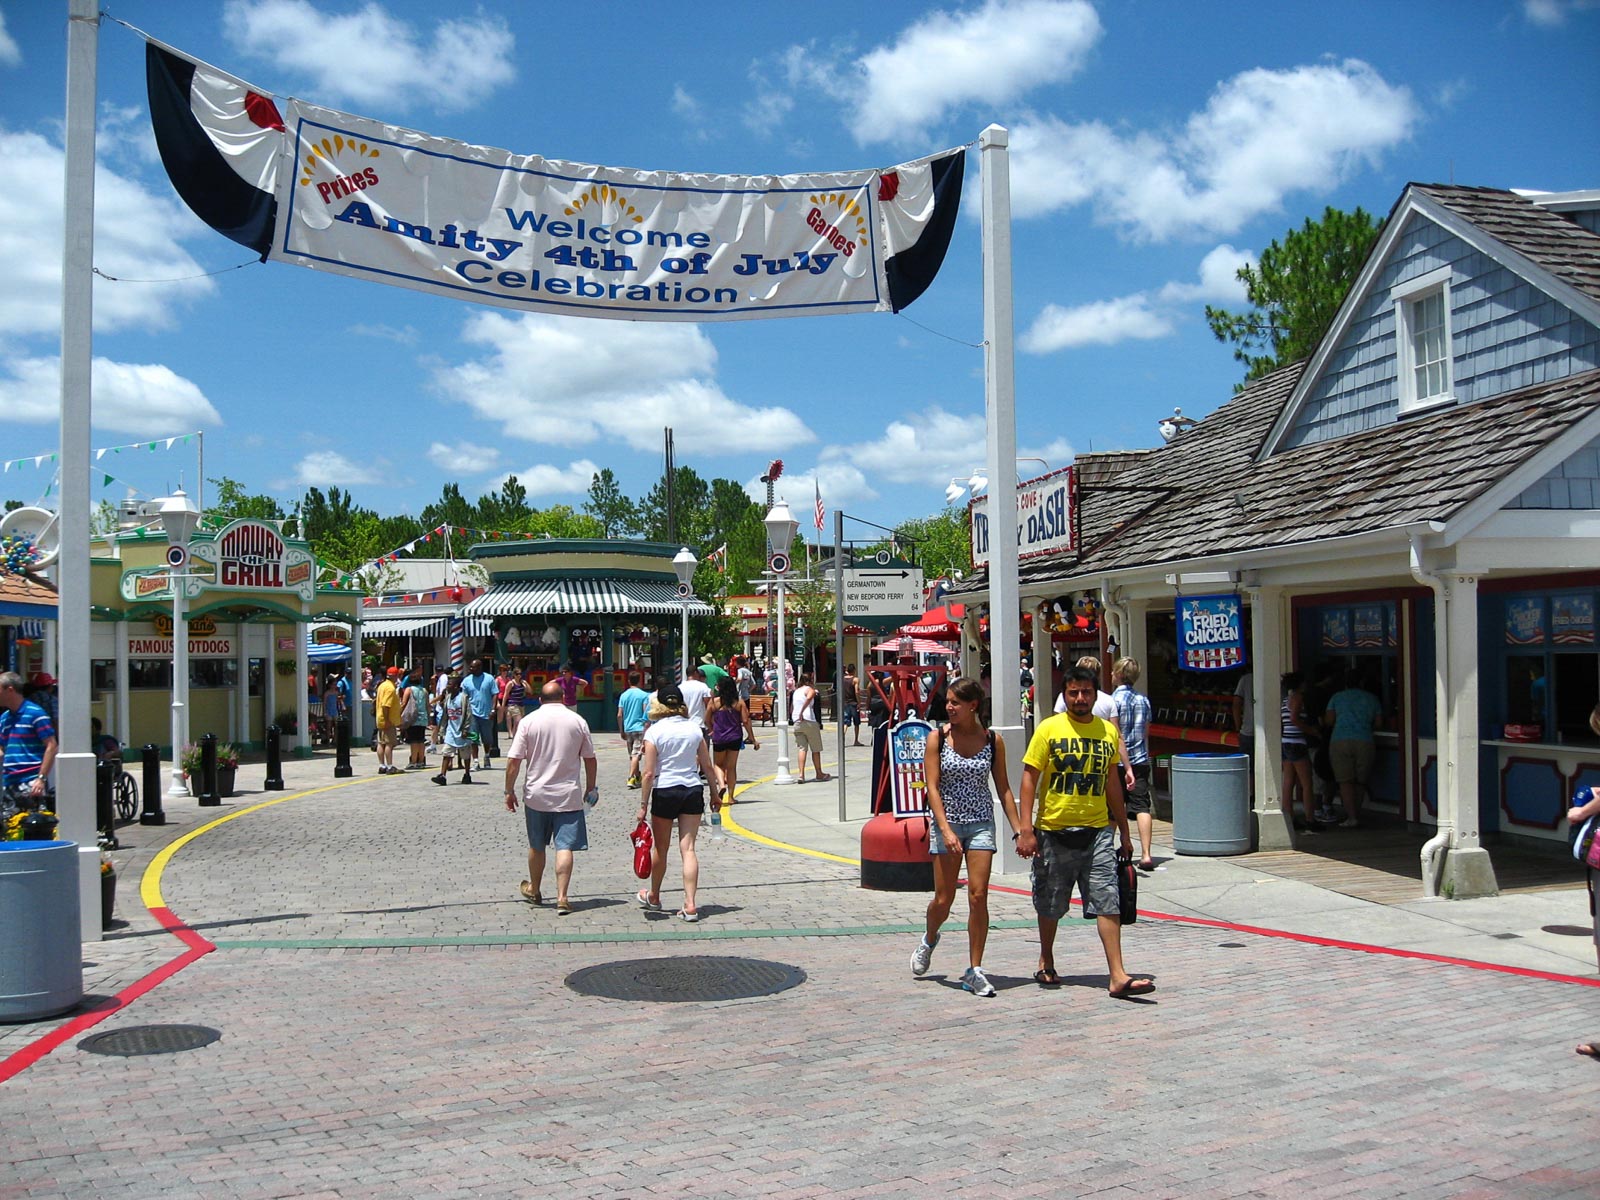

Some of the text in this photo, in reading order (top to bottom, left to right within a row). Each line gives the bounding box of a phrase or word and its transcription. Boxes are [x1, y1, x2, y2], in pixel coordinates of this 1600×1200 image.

[317, 167, 379, 205] Prizes
[506, 207, 710, 250] Welcome
[805, 206, 856, 257] Games
[335, 203, 838, 276] Amity 4th of July
[455, 260, 739, 304] Celebration
[1021, 491, 1037, 509] COVE
[1027, 487, 1066, 544] DASH
[221, 525, 283, 559] MIDWAY
[242, 556, 265, 564] THE
[222, 561, 283, 587] GRILL
[847, 603, 919, 612] BOSTON 64
[1193, 613, 1230, 630] FRIED
[1185, 626, 1239, 645] CHICKEN
[129, 640, 230, 654] FAMOUS OTDOGS
[907, 709, 917, 719] 2
[899, 749, 925, 760] CHICK
[1049, 738, 1115, 757] HATERS
[1051, 754, 1108, 774] WEL
